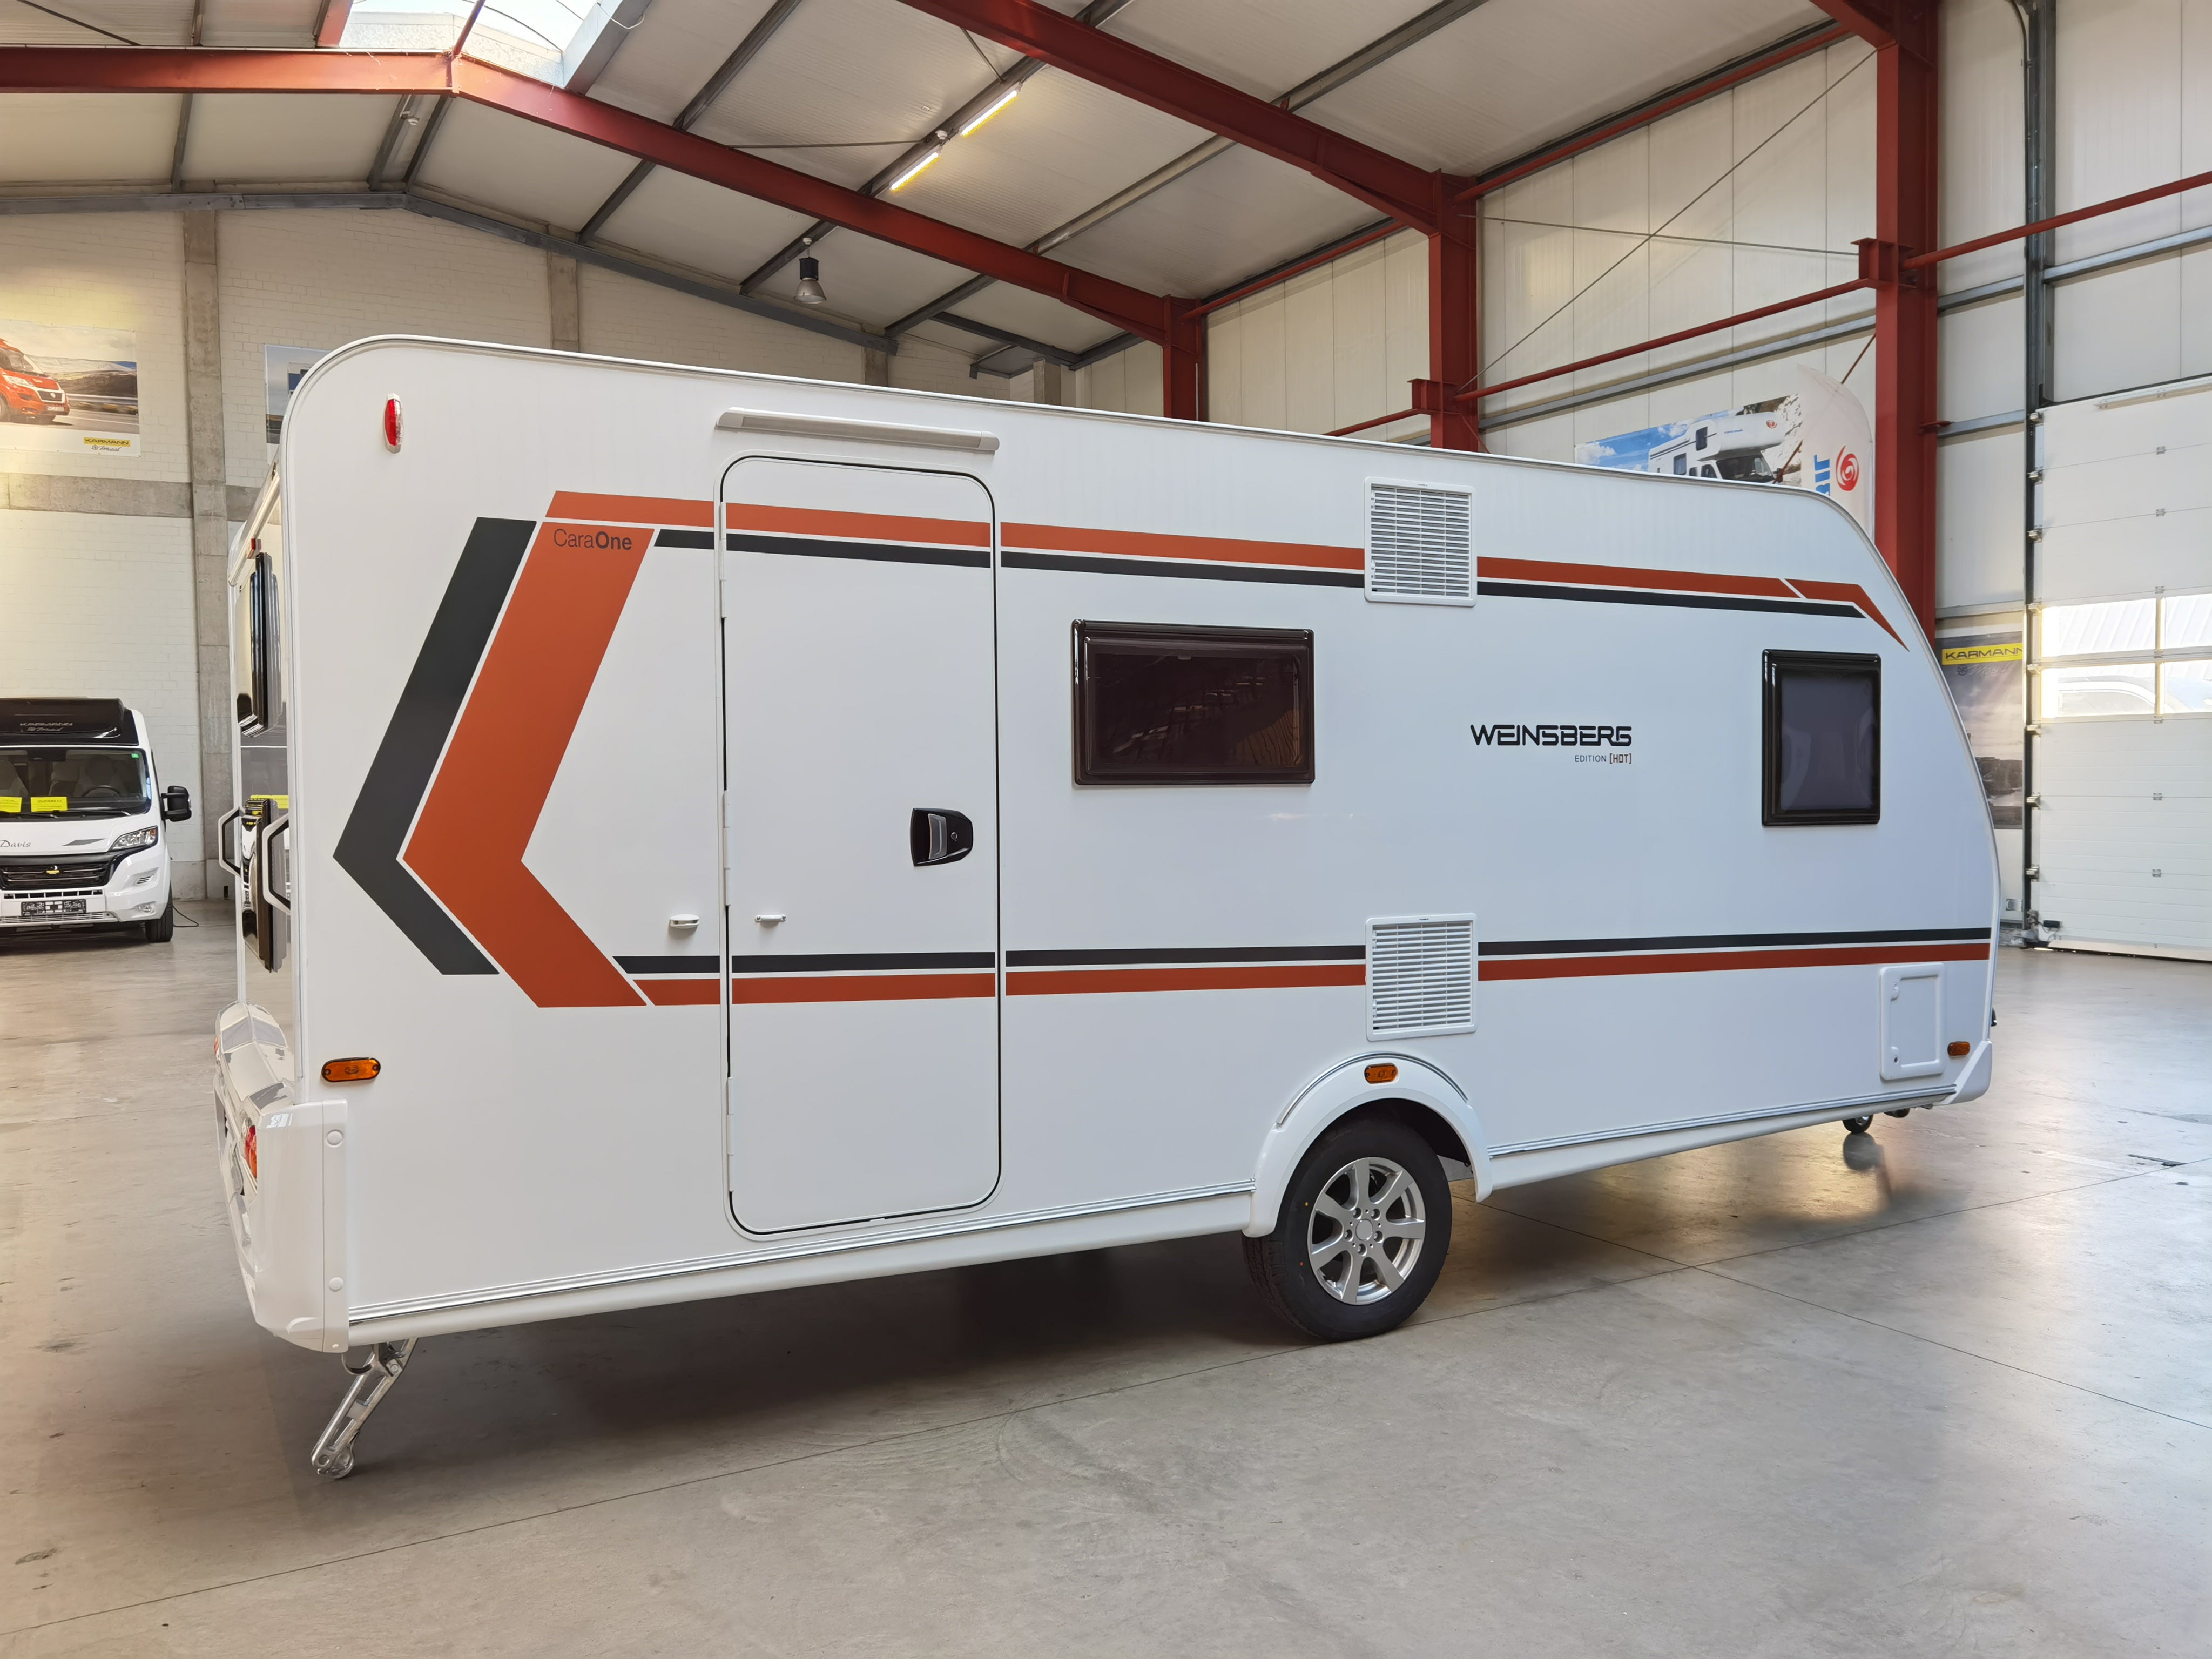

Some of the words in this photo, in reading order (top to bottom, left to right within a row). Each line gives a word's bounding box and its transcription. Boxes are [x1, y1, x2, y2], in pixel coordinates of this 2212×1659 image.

[553, 528, 632, 550] CaraOne
[1469, 724, 1633, 747] WEINSBERG
[1574, 754, 1607, 763] EDITION
